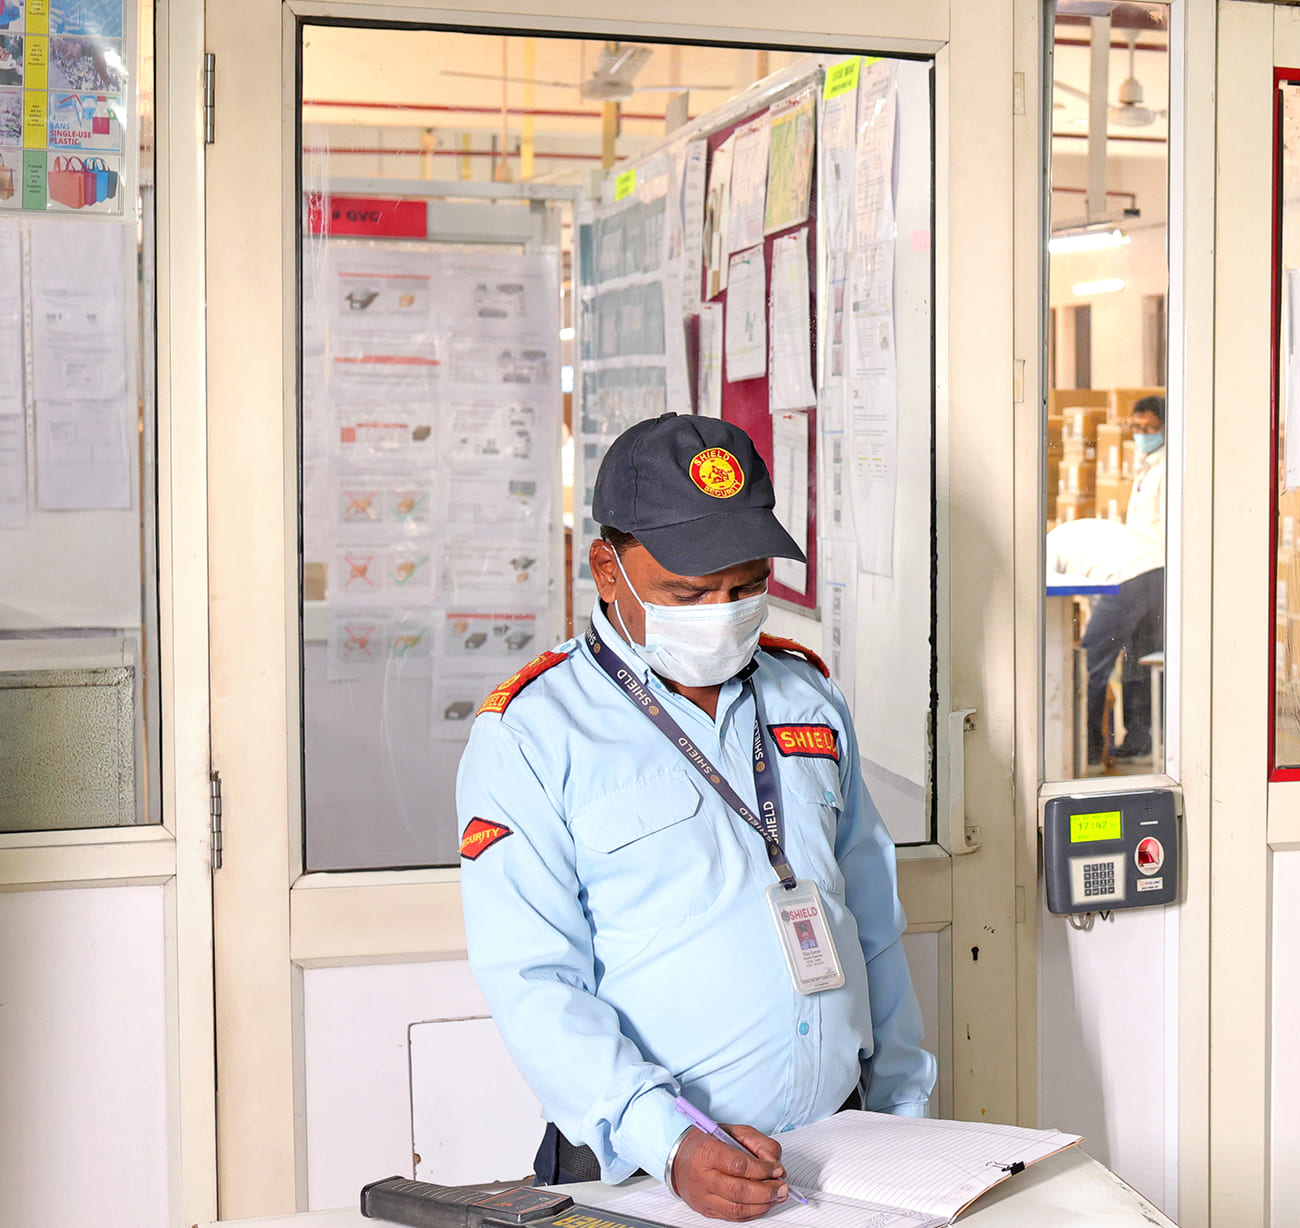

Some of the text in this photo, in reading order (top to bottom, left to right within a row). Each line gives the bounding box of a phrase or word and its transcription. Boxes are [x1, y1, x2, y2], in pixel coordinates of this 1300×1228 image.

[50, 130, 92, 138] SINGLE-USE
[694, 450, 730, 466] SHIELD
[617, 669, 652, 706] SHIELD
[678, 737, 713, 774] SHIELD
[789, 906, 818, 920] SHIELD
